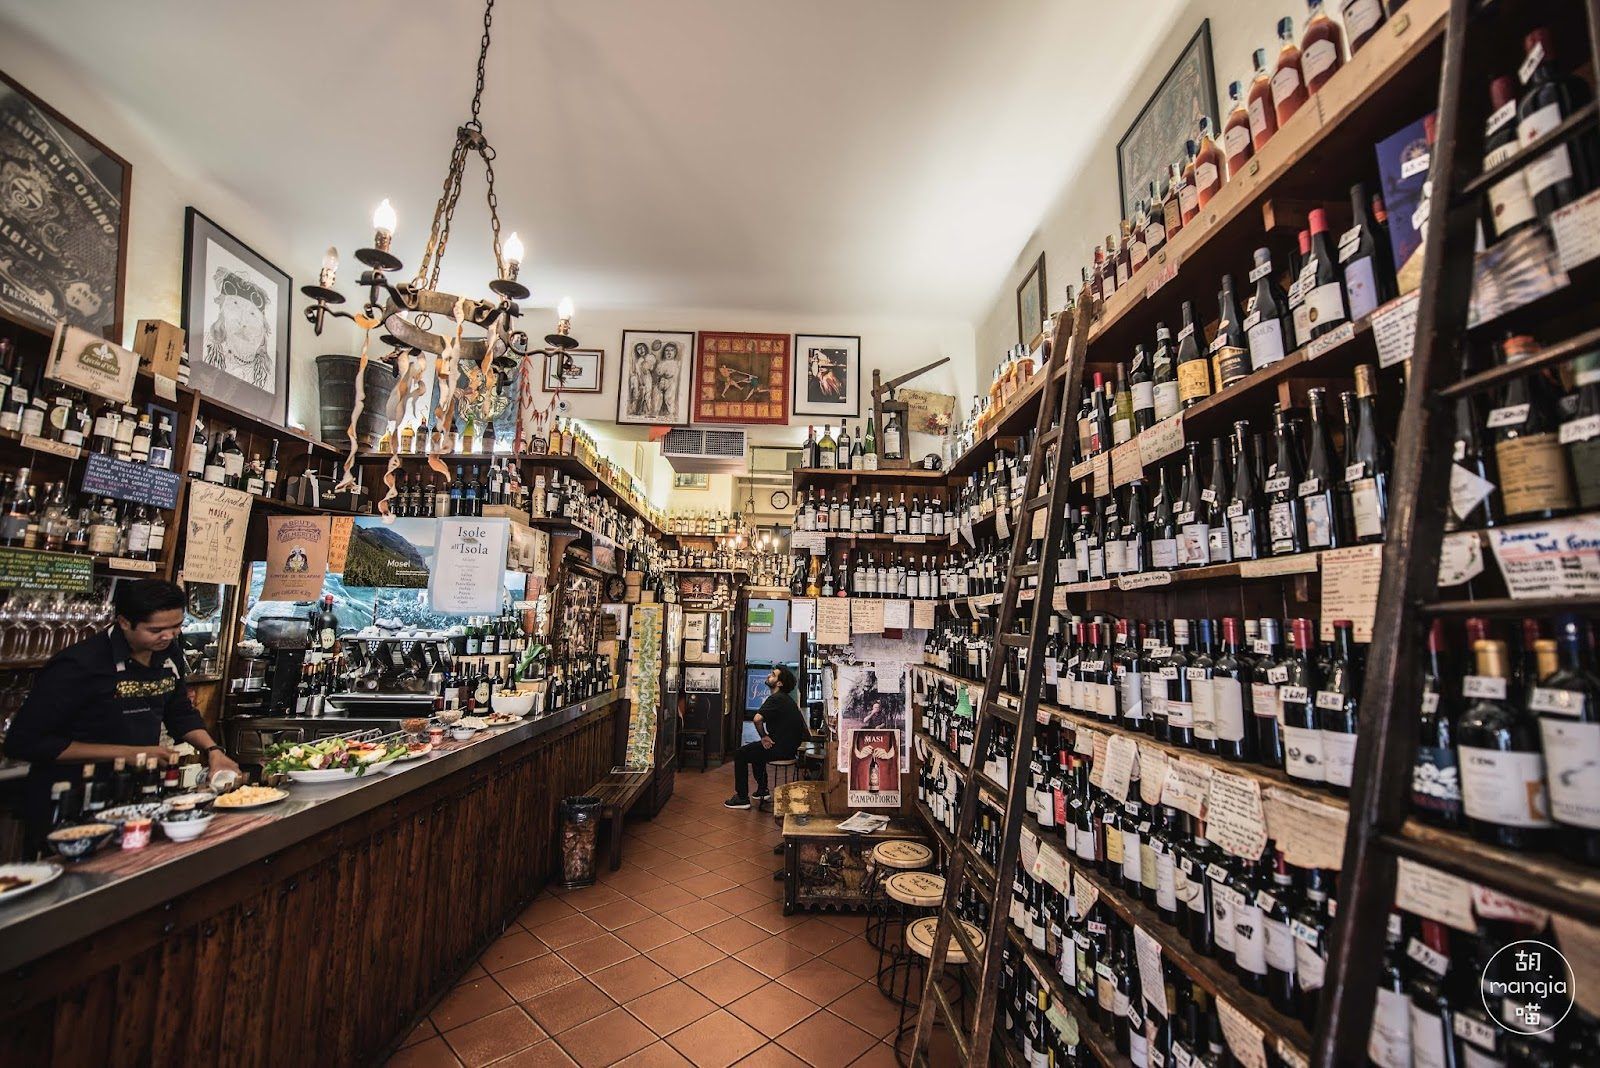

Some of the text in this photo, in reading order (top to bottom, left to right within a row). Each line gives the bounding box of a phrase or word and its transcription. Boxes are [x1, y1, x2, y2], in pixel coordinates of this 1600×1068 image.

[49, 154, 65, 171] DI
[65, 172, 115, 234] POMINO
[458, 526, 486, 538] Isole
[451, 543, 488, 555] all'Isola
[387, 559, 411, 568] Mosel
[864, 735, 883, 743] MASI
